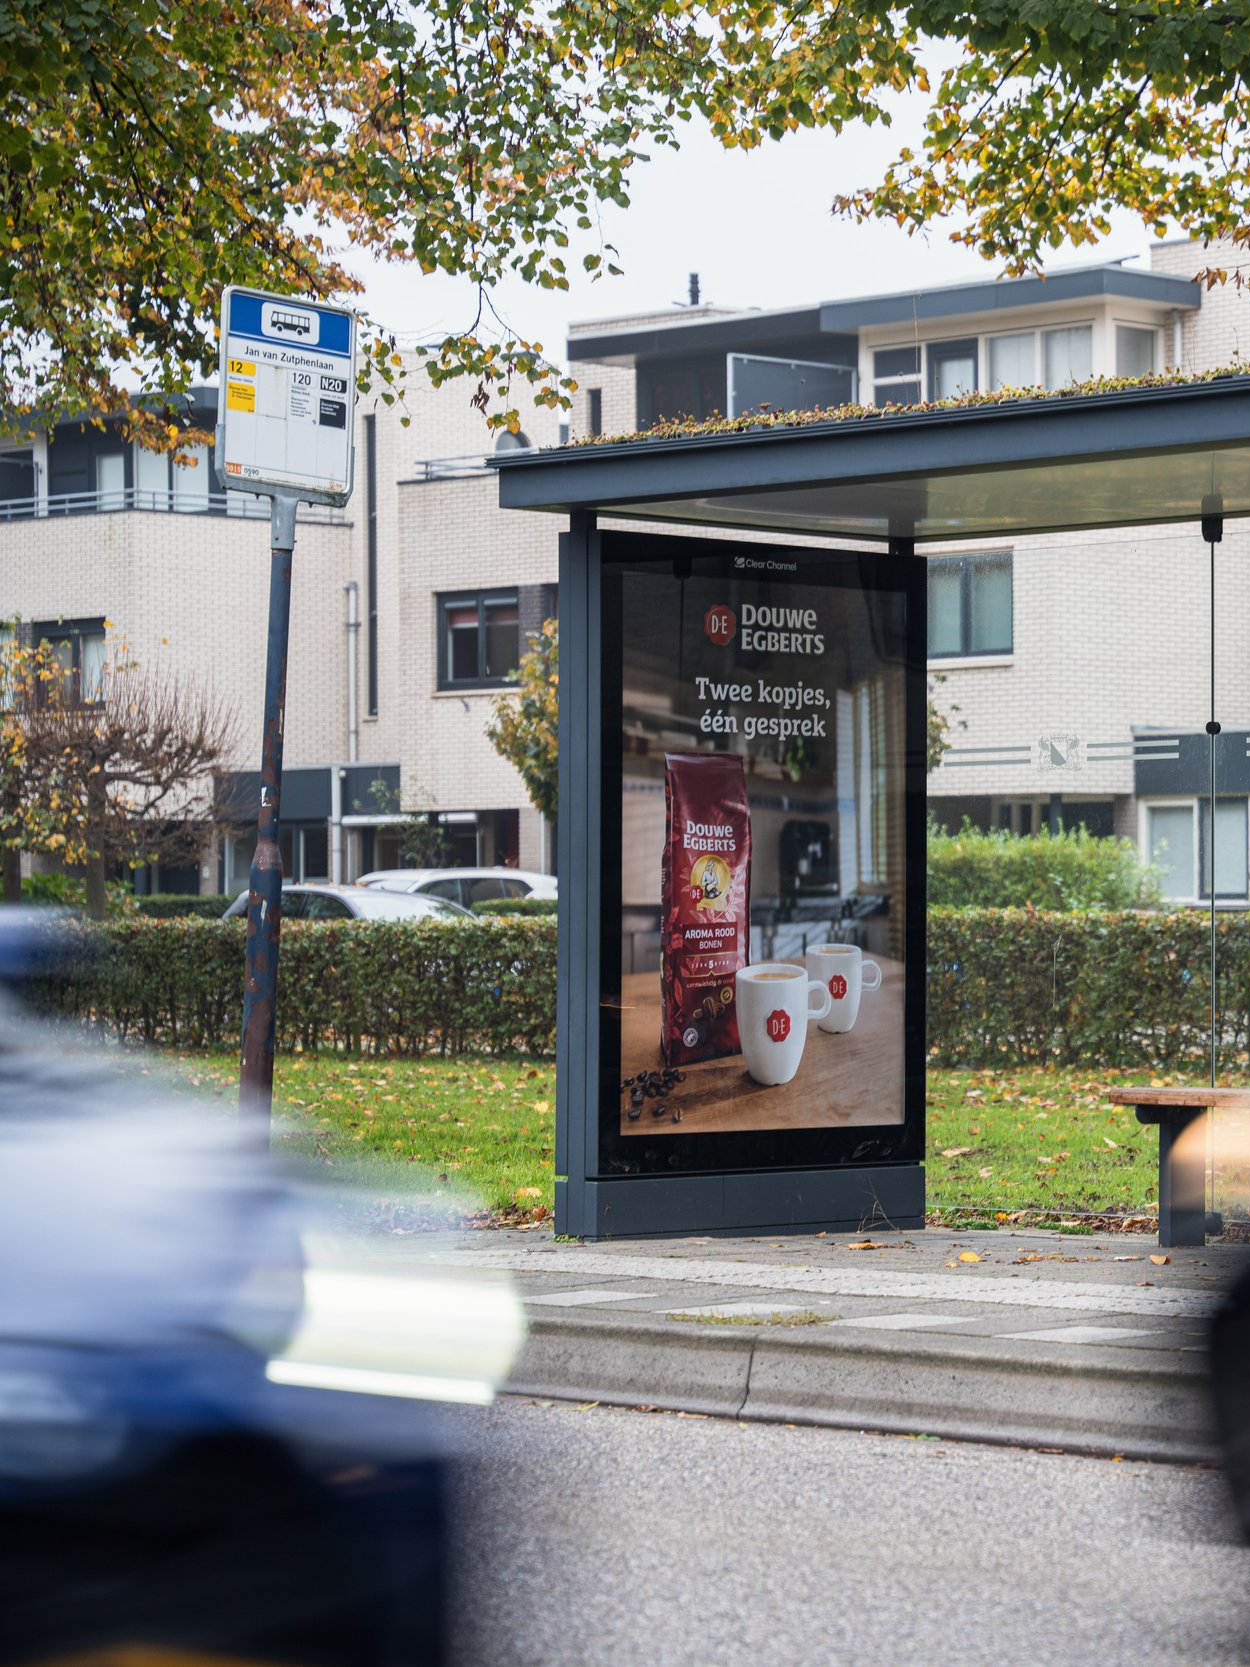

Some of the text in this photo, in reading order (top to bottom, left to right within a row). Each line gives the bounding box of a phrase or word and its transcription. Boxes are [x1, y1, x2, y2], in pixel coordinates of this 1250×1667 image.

[244, 346, 334, 371] Jan van Zutphenlaan
[230, 360, 243, 373] 12
[292, 372, 312, 386] 120
[321, 377, 342, 392] N20
[745, 559, 797, 571] Clear Channel
[741, 628, 825, 655] EGBERTS
[695, 677, 831, 710] Twee kopjes,
[700, 708, 826, 741] één gesprek
[683, 834, 737, 852] EGBERTS
[685, 927, 735, 939] AROMA ROOD
[699, 940, 723, 949] BONEN
[708, 959, 714, 969] 5
